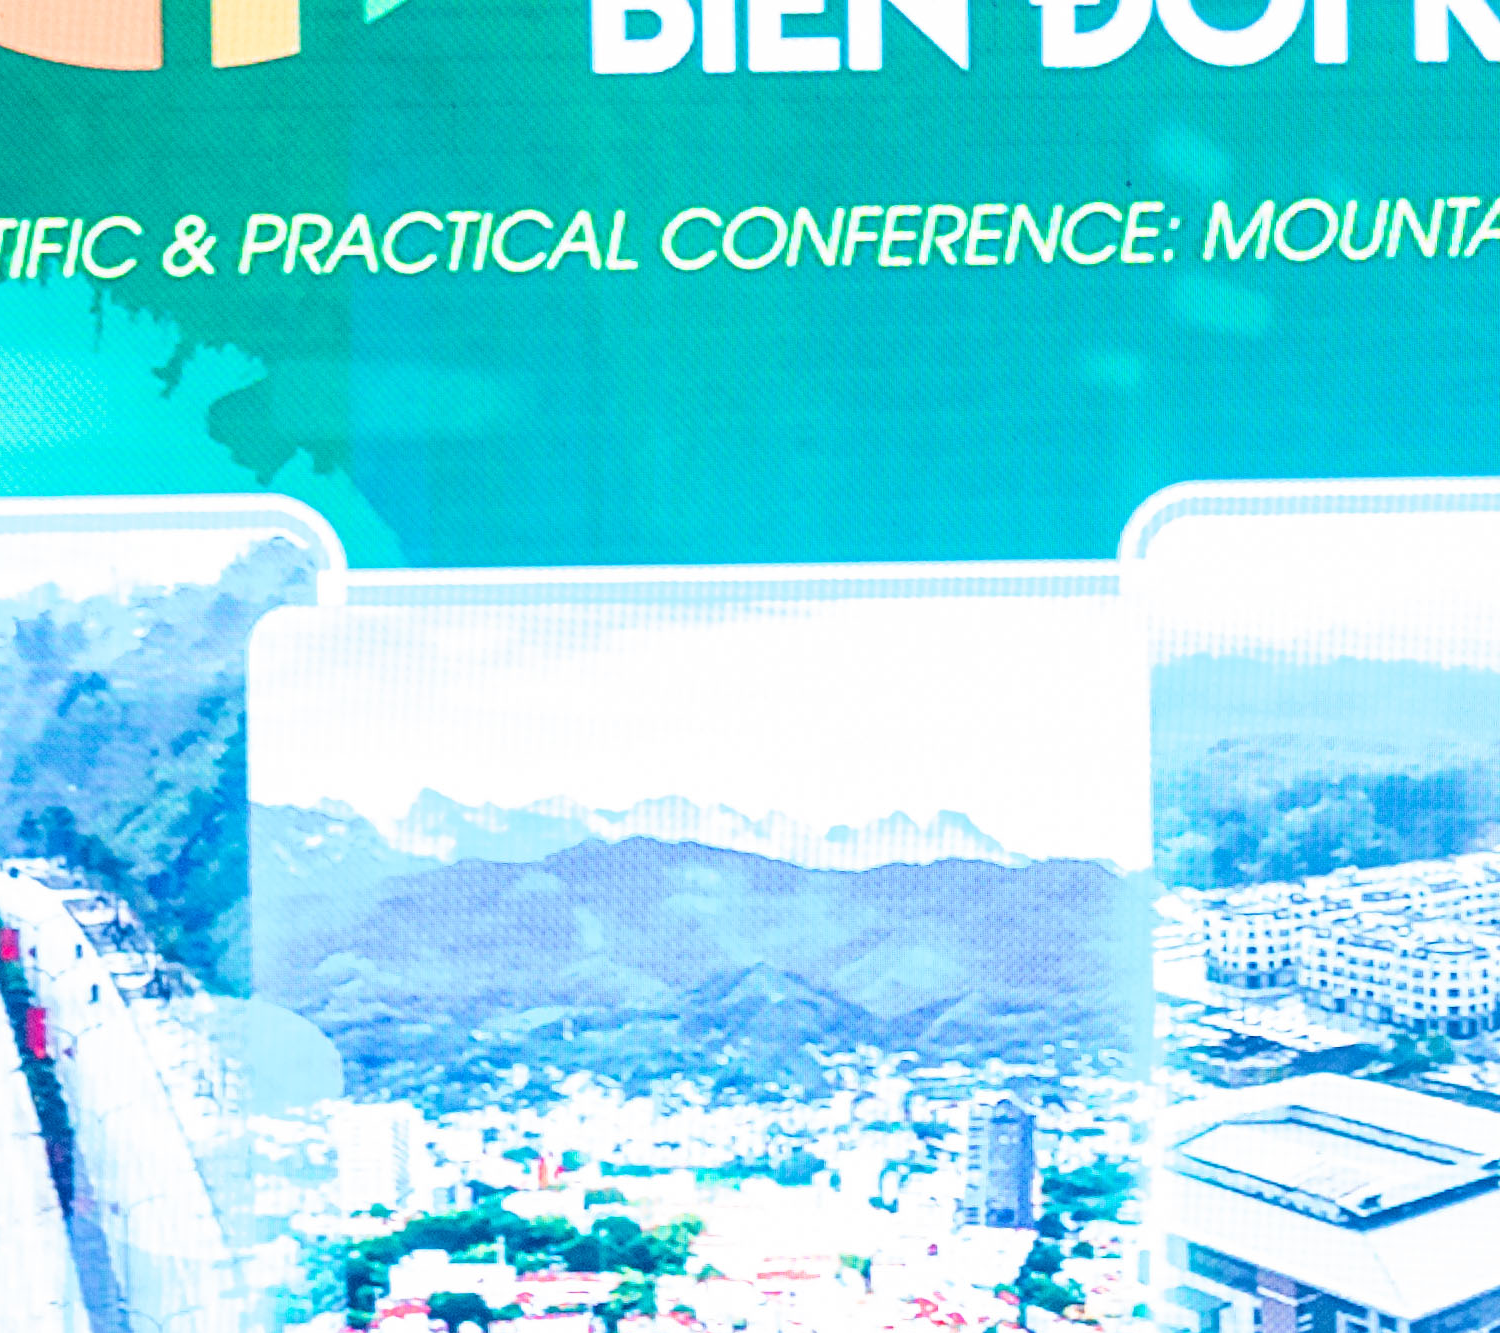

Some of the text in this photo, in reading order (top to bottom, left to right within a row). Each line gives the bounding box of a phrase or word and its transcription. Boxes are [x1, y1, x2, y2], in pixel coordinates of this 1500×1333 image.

[161, 214, 217, 277] &
[238, 208, 640, 274] PRACTICAL
[660, 201, 1180, 270] CONFERENCE:
